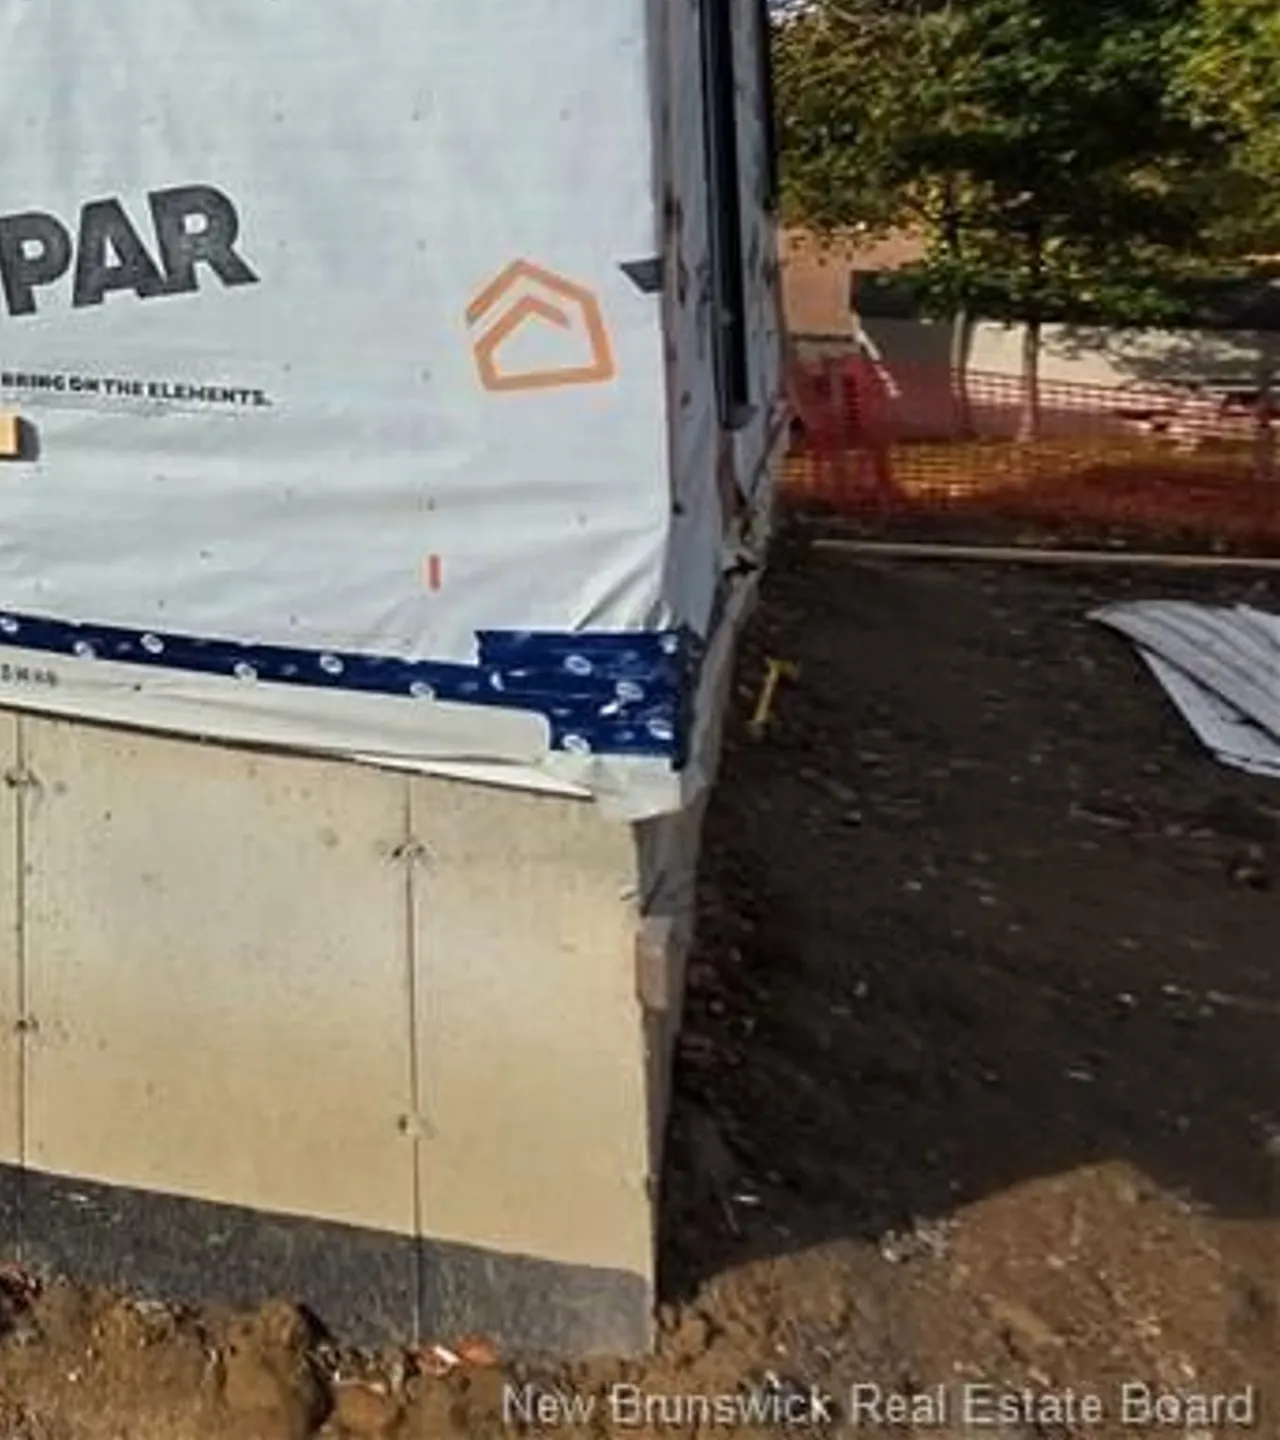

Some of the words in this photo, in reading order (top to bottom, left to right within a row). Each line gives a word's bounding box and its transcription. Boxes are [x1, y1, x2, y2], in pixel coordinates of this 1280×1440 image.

[0, 371, 66, 392] BRING
[68, 375, 99, 394] ON
[101, 377, 144, 398] THE
